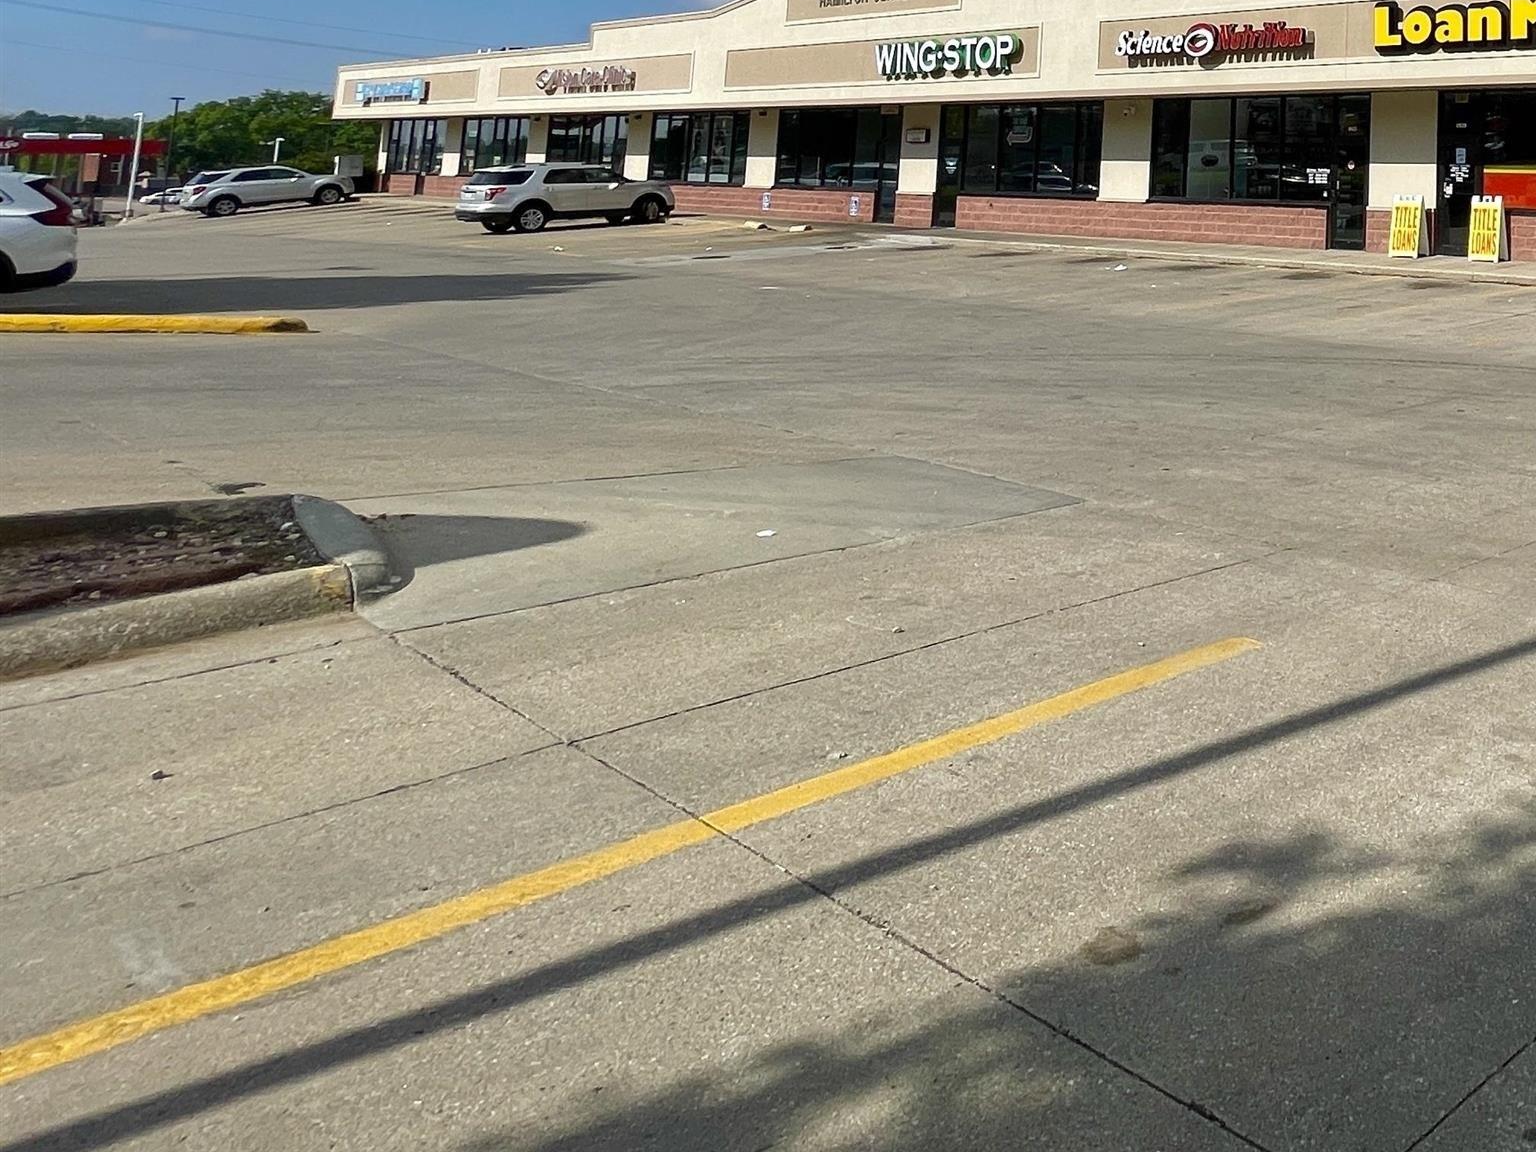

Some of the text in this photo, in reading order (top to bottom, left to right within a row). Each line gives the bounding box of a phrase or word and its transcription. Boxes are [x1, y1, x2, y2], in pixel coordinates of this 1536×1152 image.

[1115, 22, 1305, 57] Science Nutrition
[1394, 206, 1418, 228] TITLE
[1473, 208, 1498, 231] TITLE
[1392, 229, 1417, 251] LOANS
[1471, 232, 1497, 255] LOANS
